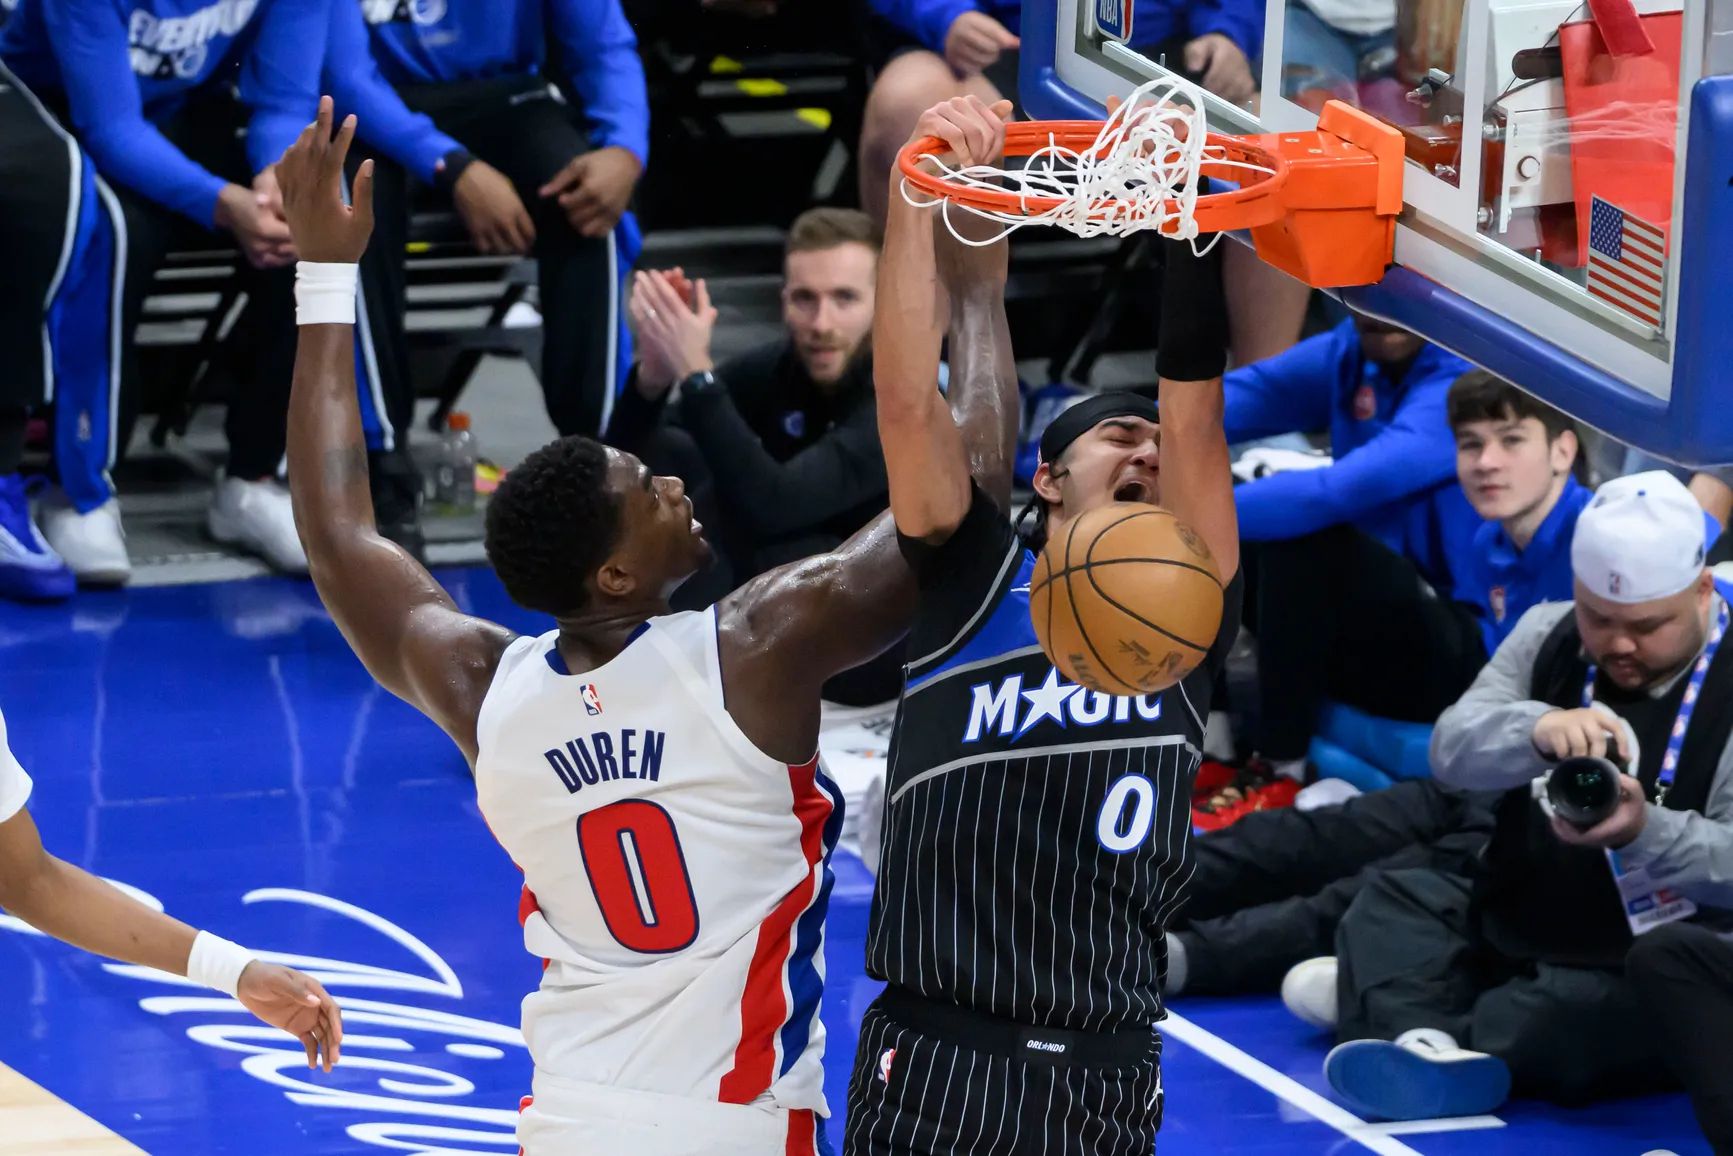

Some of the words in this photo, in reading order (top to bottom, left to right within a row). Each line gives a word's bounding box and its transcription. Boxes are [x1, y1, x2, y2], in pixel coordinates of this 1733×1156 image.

[1099, 0, 1118, 27] NBA
[543, 728, 666, 795] DUREN
[1095, 772, 1156, 854] 0
[576, 798, 700, 954] 0
[1026, 1039, 1066, 1053] ORLANDO
